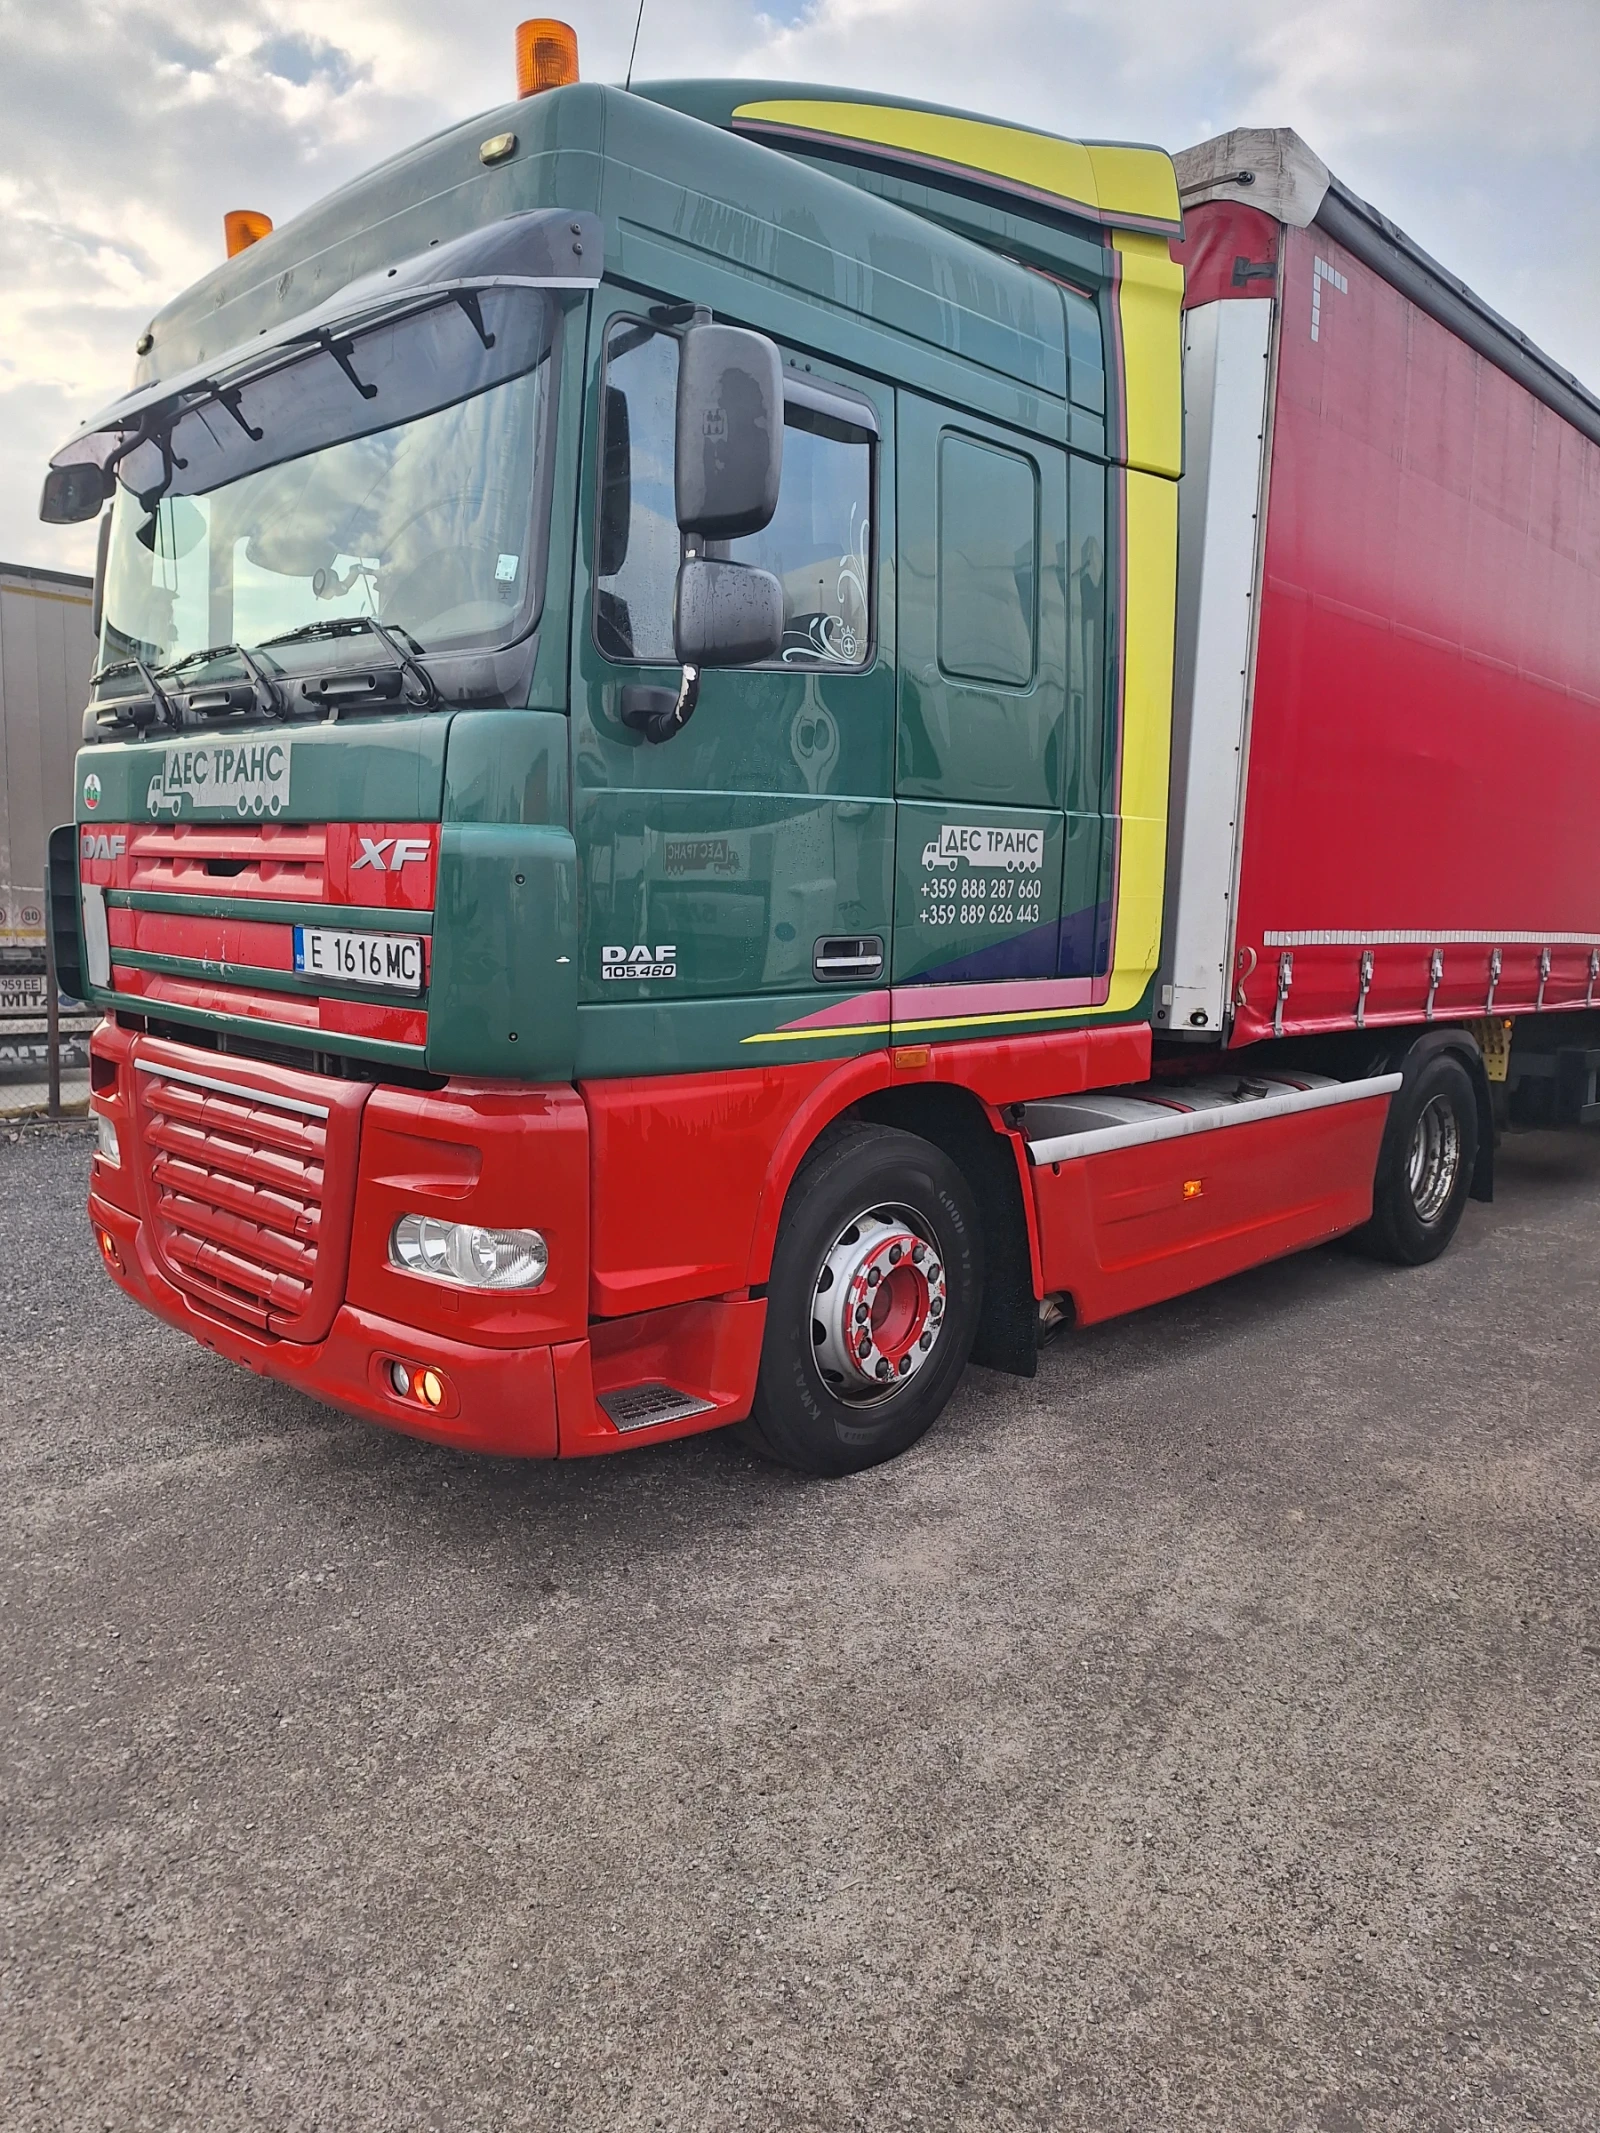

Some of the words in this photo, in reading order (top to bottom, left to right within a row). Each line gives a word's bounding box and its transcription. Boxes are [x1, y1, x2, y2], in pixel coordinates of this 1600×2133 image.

[169, 751, 208, 789] ДЕС
[214, 745, 284, 784] ТРАНС
[82, 835, 126, 860] DAF
[945, 829, 982, 853] ДЕС
[987, 831, 1039, 854] ТРАНС
[351, 838, 431, 871] XF
[920, 878, 957, 899] +359
[961, 878, 987, 899] 888
[990, 879, 1015, 899] 287
[1018, 879, 1042, 899] 660
[25, 910, 38, 921] 80
[920, 904, 956, 925] +359
[960, 904, 986, 924] 889
[989, 904, 1013, 924] 626
[1016, 903, 1040, 923] 443
[311, 935, 323, 969] E
[602, 945, 677, 963] DAF
[604, 965, 675, 978] 105.460
